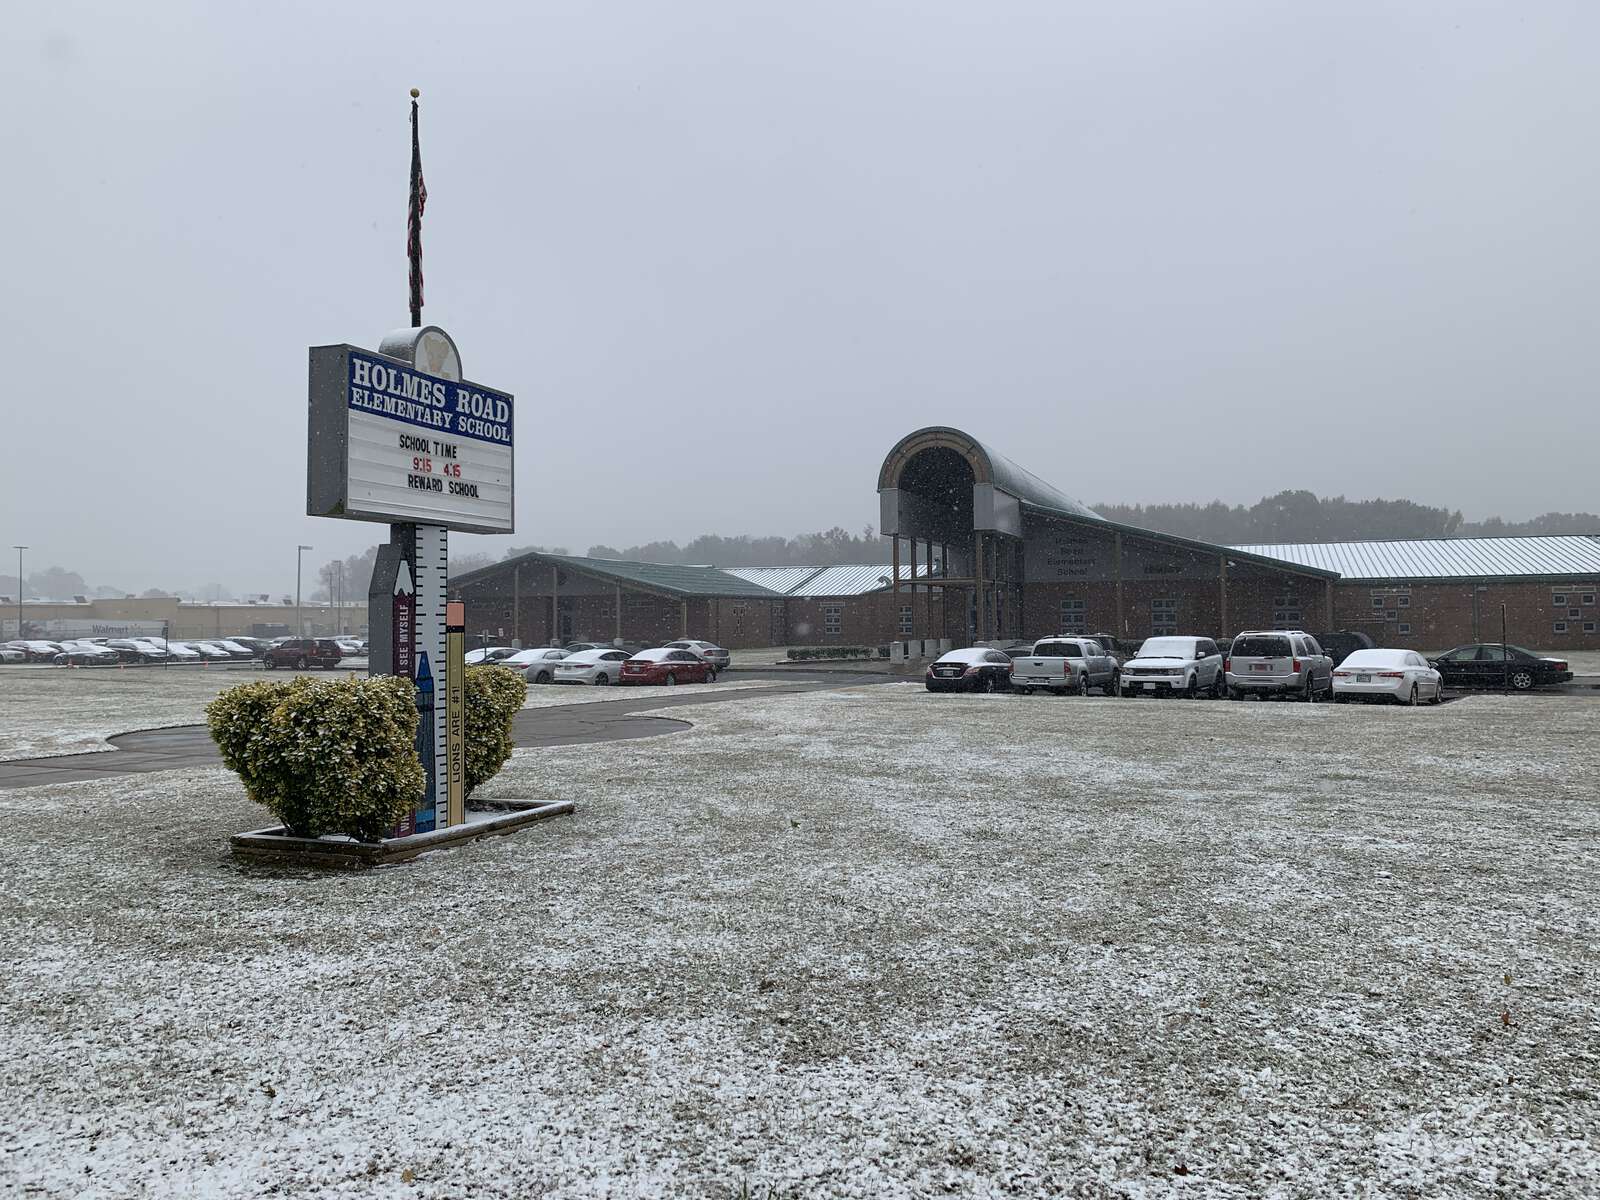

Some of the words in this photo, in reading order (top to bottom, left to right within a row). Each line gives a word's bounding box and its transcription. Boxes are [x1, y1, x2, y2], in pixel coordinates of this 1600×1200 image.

[353, 358, 446, 408] HOLMES
[456, 389, 509, 423] ROAD
[351, 387, 453, 428] ELEMENTARY
[458, 415, 510, 442] SCHOOL
[399, 434, 430, 454] SCHOOL
[433, 441, 457, 459] TIME
[413, 457, 432, 473] 9:15
[444, 462, 461, 478] 4:15
[408, 474, 443, 492] REWARD
[448, 481, 479, 498] SCHOOL
[91, 623, 128, 634] Walmart
[399, 604, 409, 643] MYSELF
[399, 647, 409, 666] SEE
[451, 711, 460, 737] ARE
[452, 743, 461, 783] LIONS
